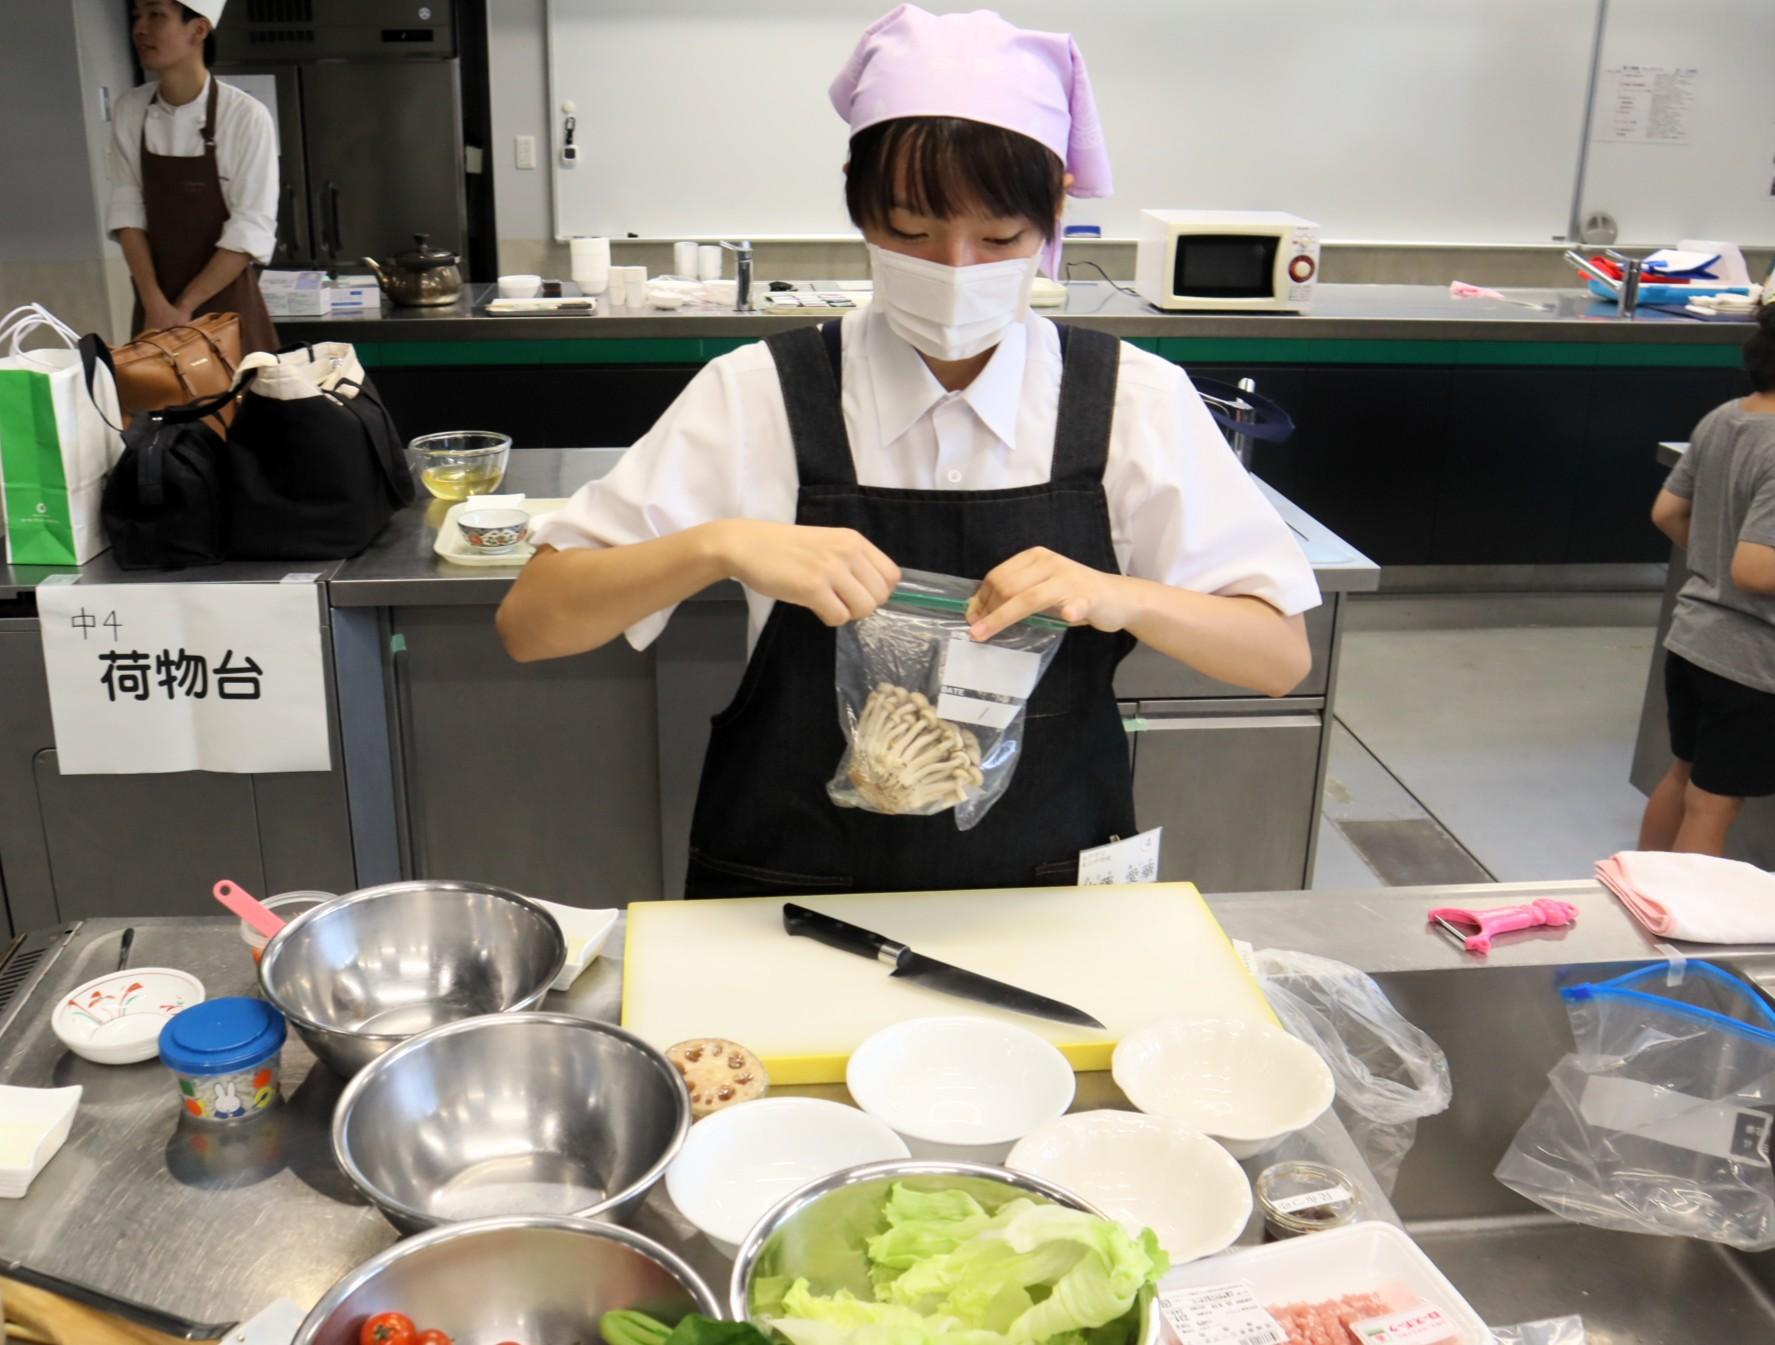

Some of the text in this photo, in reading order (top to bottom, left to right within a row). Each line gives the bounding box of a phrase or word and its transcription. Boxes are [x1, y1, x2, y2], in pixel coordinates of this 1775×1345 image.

[71, 607, 123, 642] 中4
[98, 648, 263, 702] 荷物台
[940, 685, 966, 697] DATE
